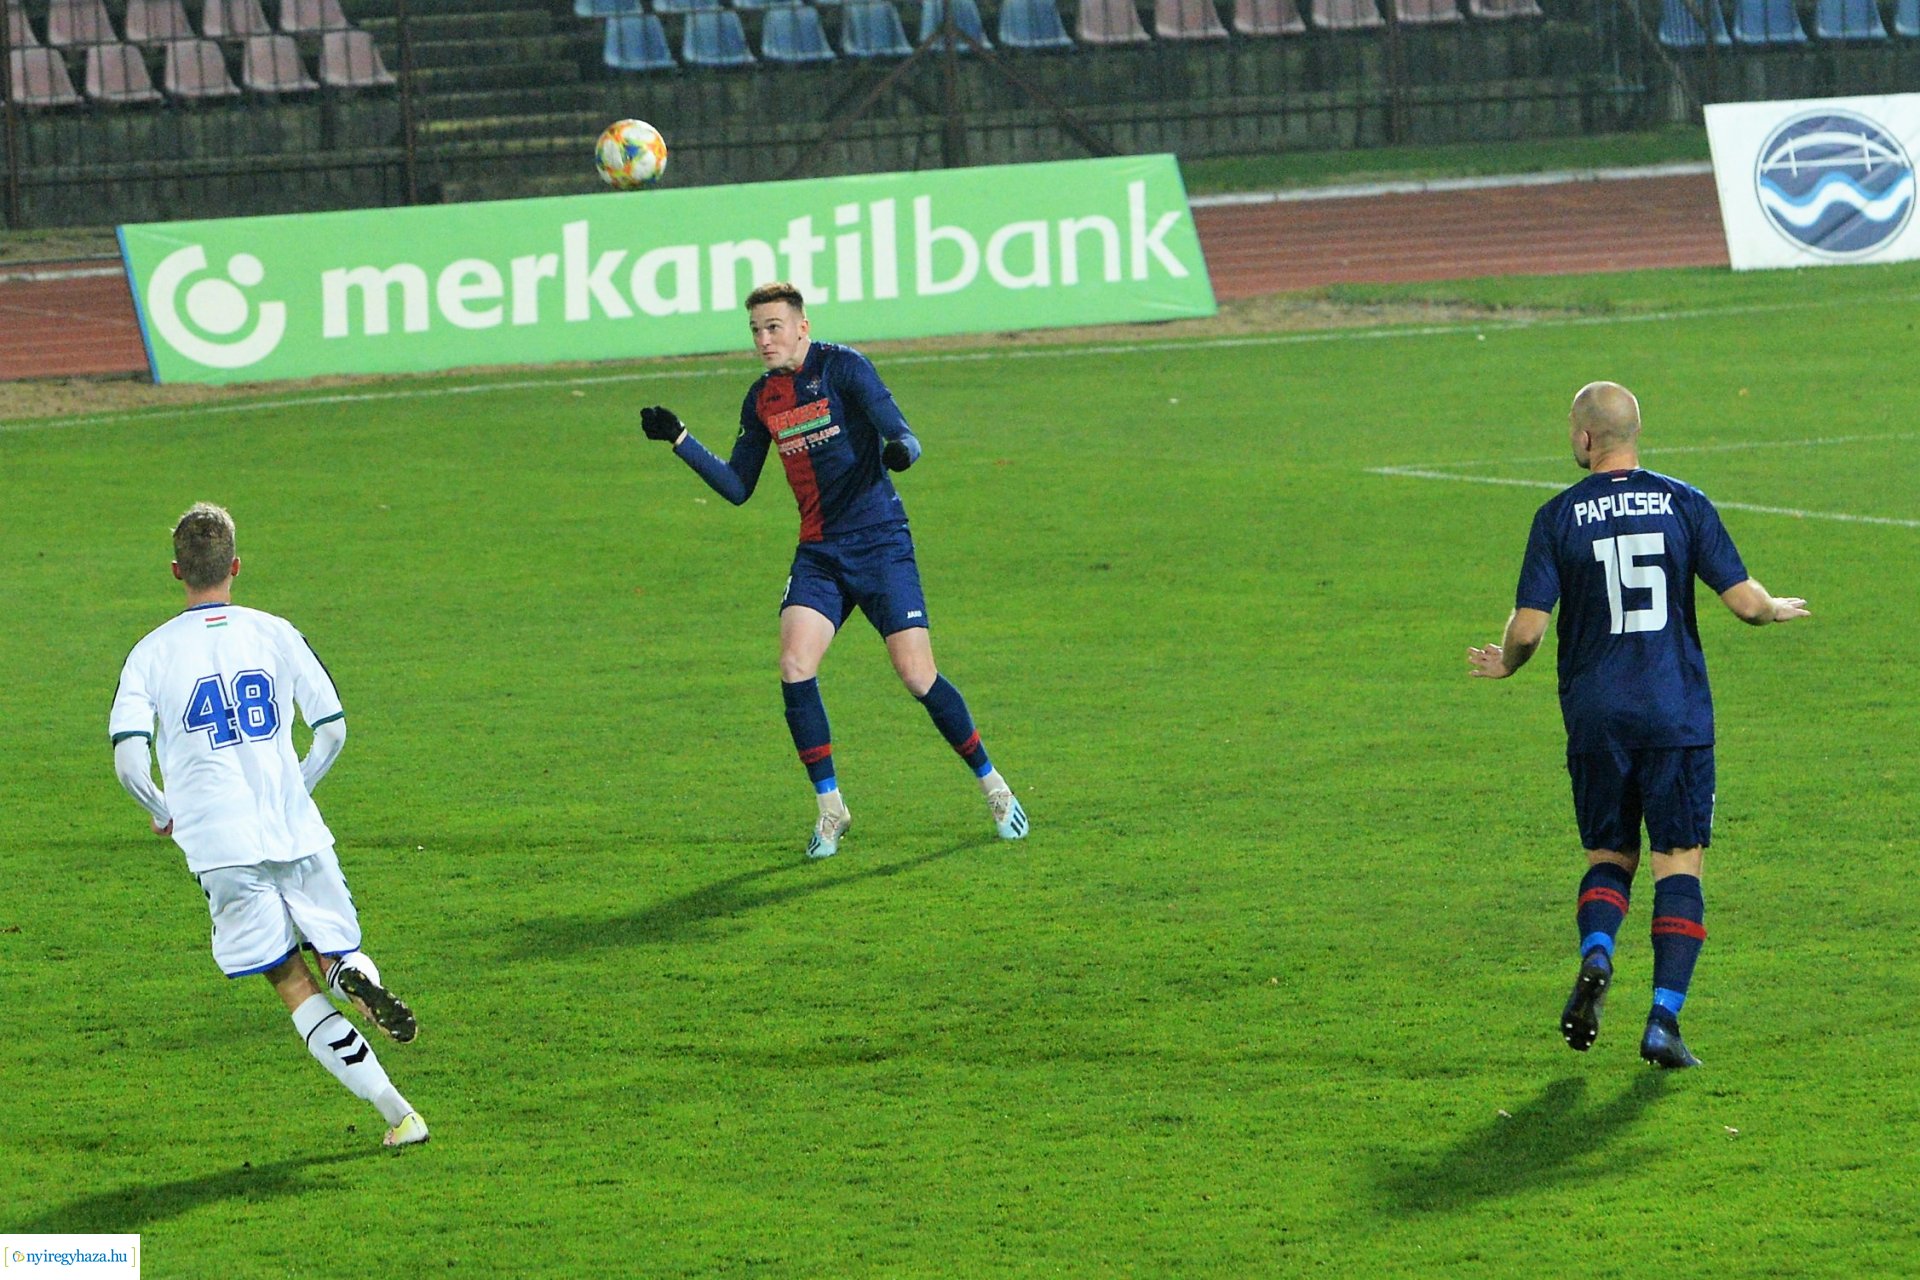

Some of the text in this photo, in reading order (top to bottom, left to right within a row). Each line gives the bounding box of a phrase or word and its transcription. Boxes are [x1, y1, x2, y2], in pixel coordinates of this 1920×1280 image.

[1574, 492, 1674, 527] PAPUCSEK
[1592, 532, 1668, 635] 15
[182, 668, 281, 750] 48
